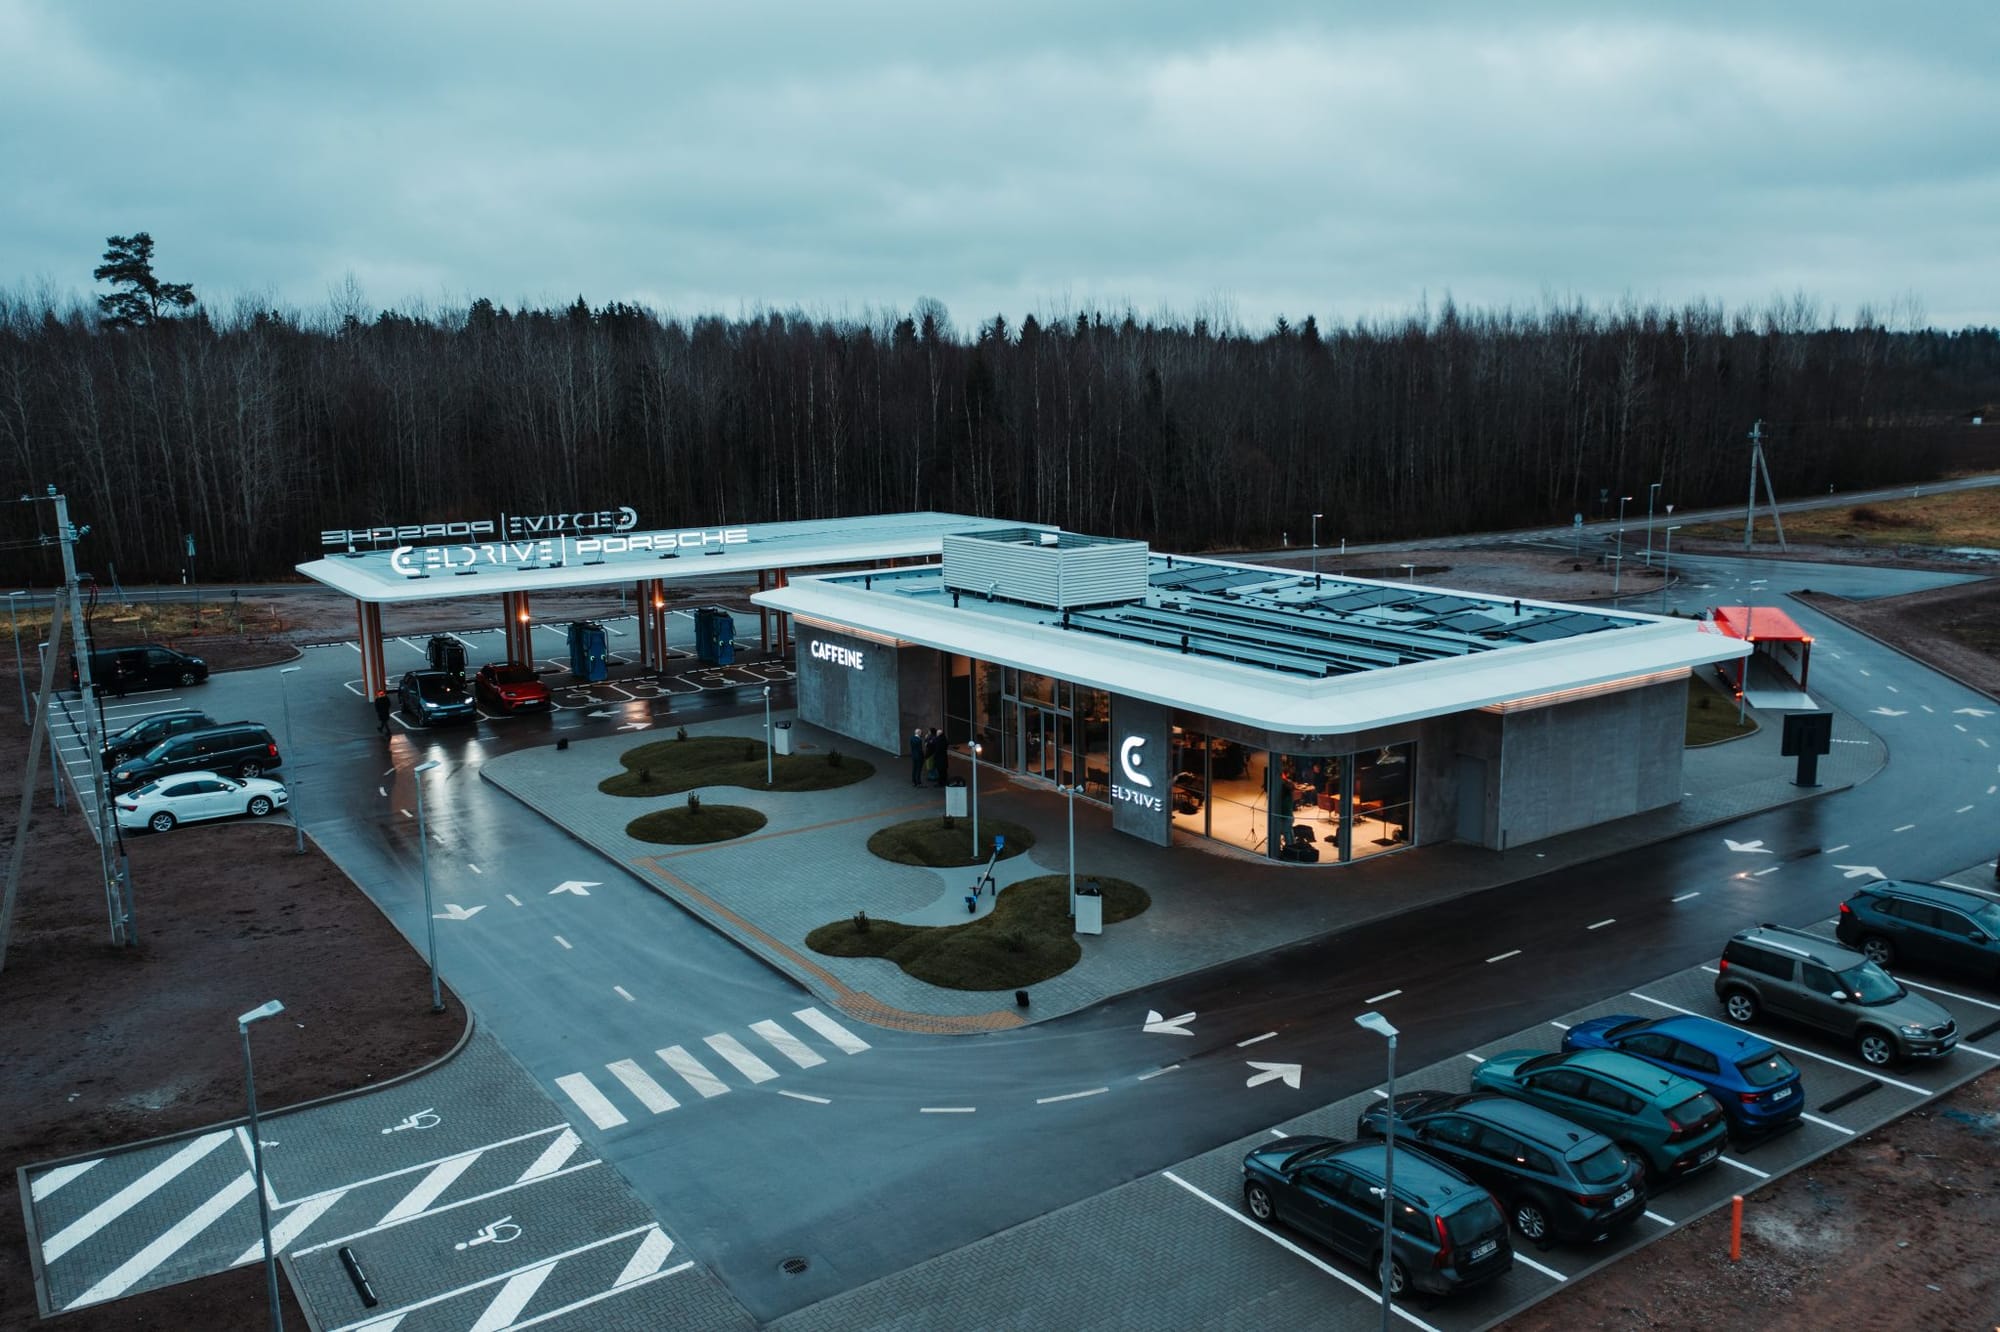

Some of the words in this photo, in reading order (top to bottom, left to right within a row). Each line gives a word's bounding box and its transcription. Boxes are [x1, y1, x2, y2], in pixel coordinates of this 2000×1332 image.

[426, 541, 552, 569] ELDRIVE
[576, 529, 749, 555] PORSCHE
[811, 640, 864, 670] CAFFEINE
[1111, 784, 1162, 811] ELDRIVE
